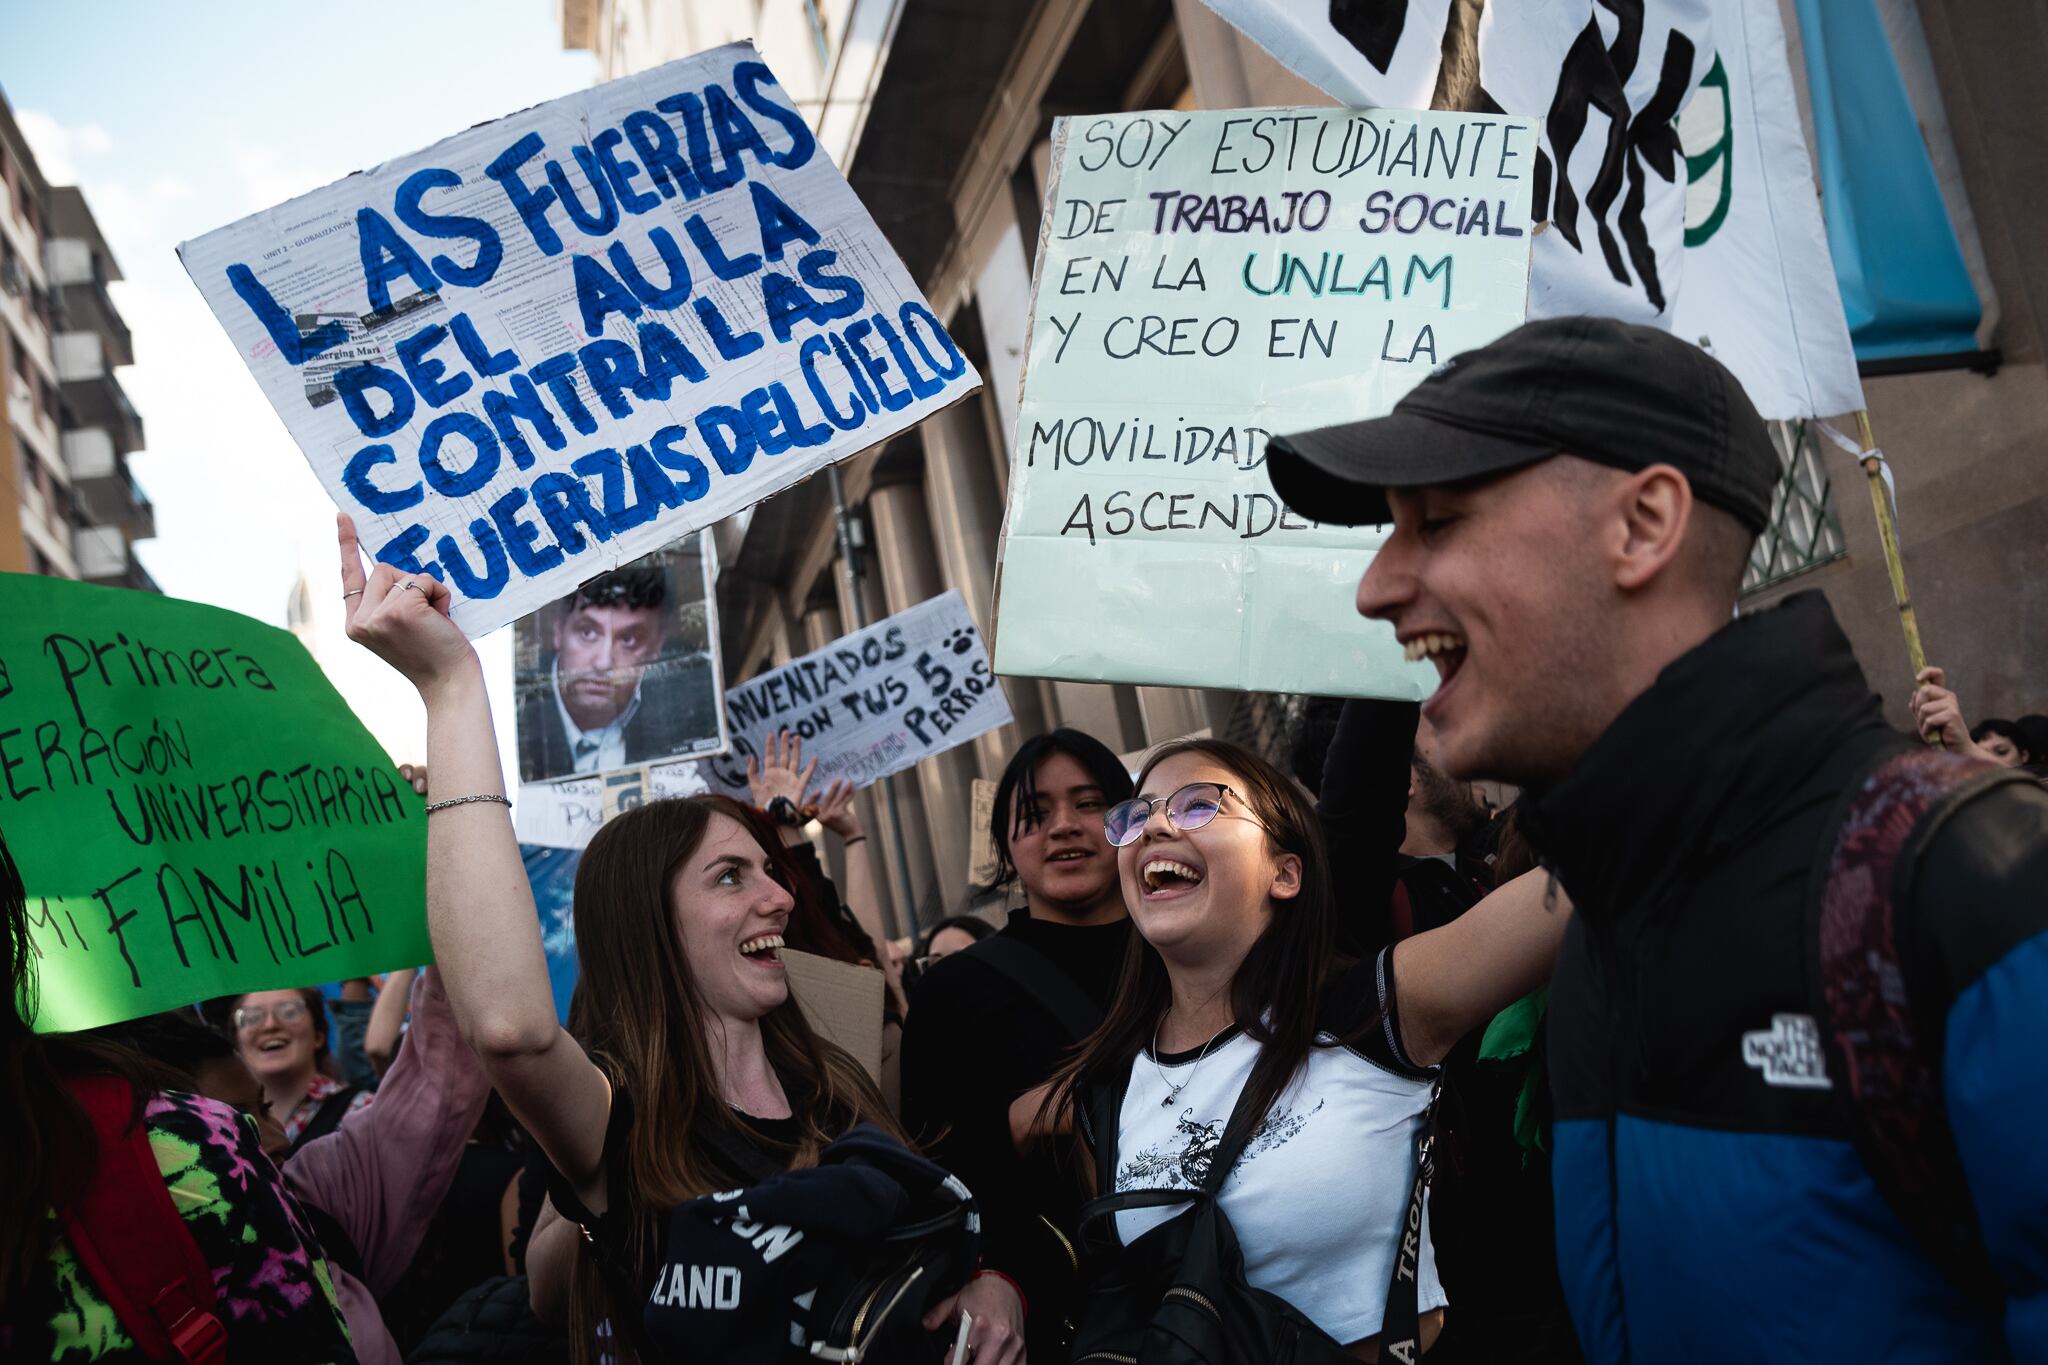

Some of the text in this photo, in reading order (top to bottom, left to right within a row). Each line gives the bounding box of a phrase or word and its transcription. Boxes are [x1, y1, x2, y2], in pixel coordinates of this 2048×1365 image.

[1079, 118, 1191, 172] SOY
[226, 169, 504, 365] LAS
[485, 61, 815, 256] FUERZAS
[295, 220, 352, 248] GLOBALIZATION
[1057, 199, 1127, 240] DE
[1150, 189, 1332, 235] TRABAJO
[333, 312, 521, 438] DEL
[572, 181, 821, 337] AULA
[1059, 252, 1454, 310] EN LA UNLAM
[1049, 311, 1438, 365] Y CREO EN LA
[342, 321, 709, 515] CONTRA
[692, 249, 864, 361] LAS
[375, 425, 710, 599] FUERZAS
[695, 382, 835, 475] DEL
[800, 302, 966, 430] CIELO
[1061, 489, 1382, 546] ASCENDE
[841, 676, 909, 742] TUS
[913, 652, 953, 697] 5
[903, 659, 996, 747] PERROS
[649, 1262, 742, 1311] LAND
